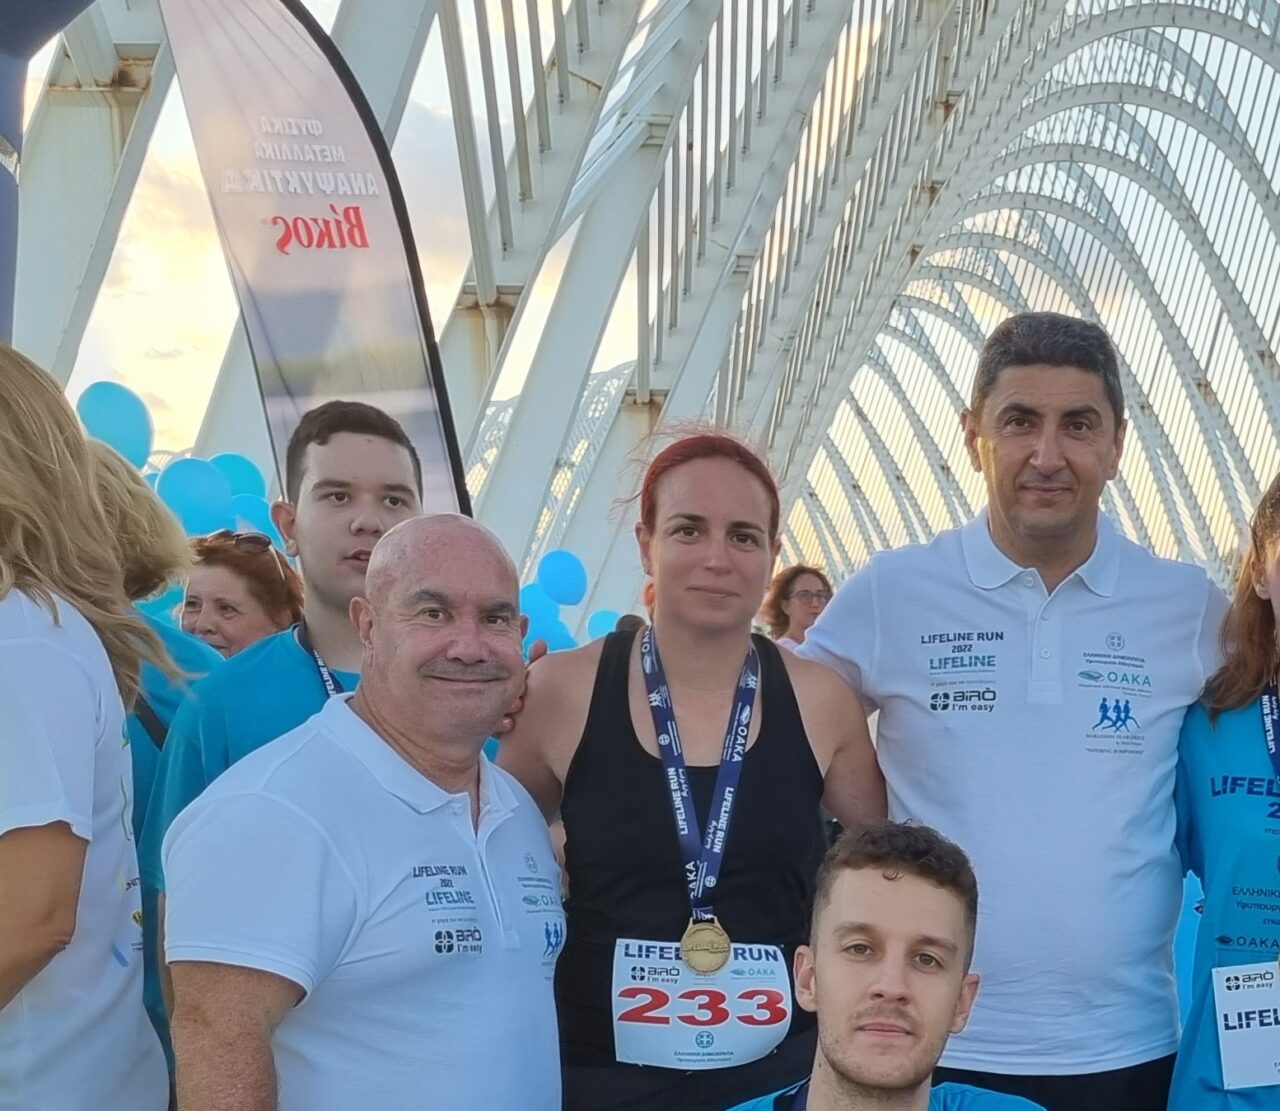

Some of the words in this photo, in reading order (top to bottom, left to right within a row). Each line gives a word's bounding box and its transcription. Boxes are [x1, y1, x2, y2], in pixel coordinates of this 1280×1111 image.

[921, 632, 974, 644] LIFELINE
[977, 631, 1004, 641] RUN
[951, 644, 973, 654] 2022
[929, 655, 996, 670] LIFELINE
[1107, 671, 1151, 687] OAKA
[952, 703, 968, 712] I'm
[970, 704, 994, 713] easy
[731, 726, 748, 762] OAKA
[413, 866, 451, 878] LIFELINE
[452, 865, 468, 876] RUN
[426, 891, 474, 906] LIFELINE
[1236, 936, 1280, 949] OAKA
[733, 947, 779, 962] RUN
[747, 968, 776, 977] OAKA
[1256, 982, 1273, 990] easy
[617, 987, 788, 1026] 233
